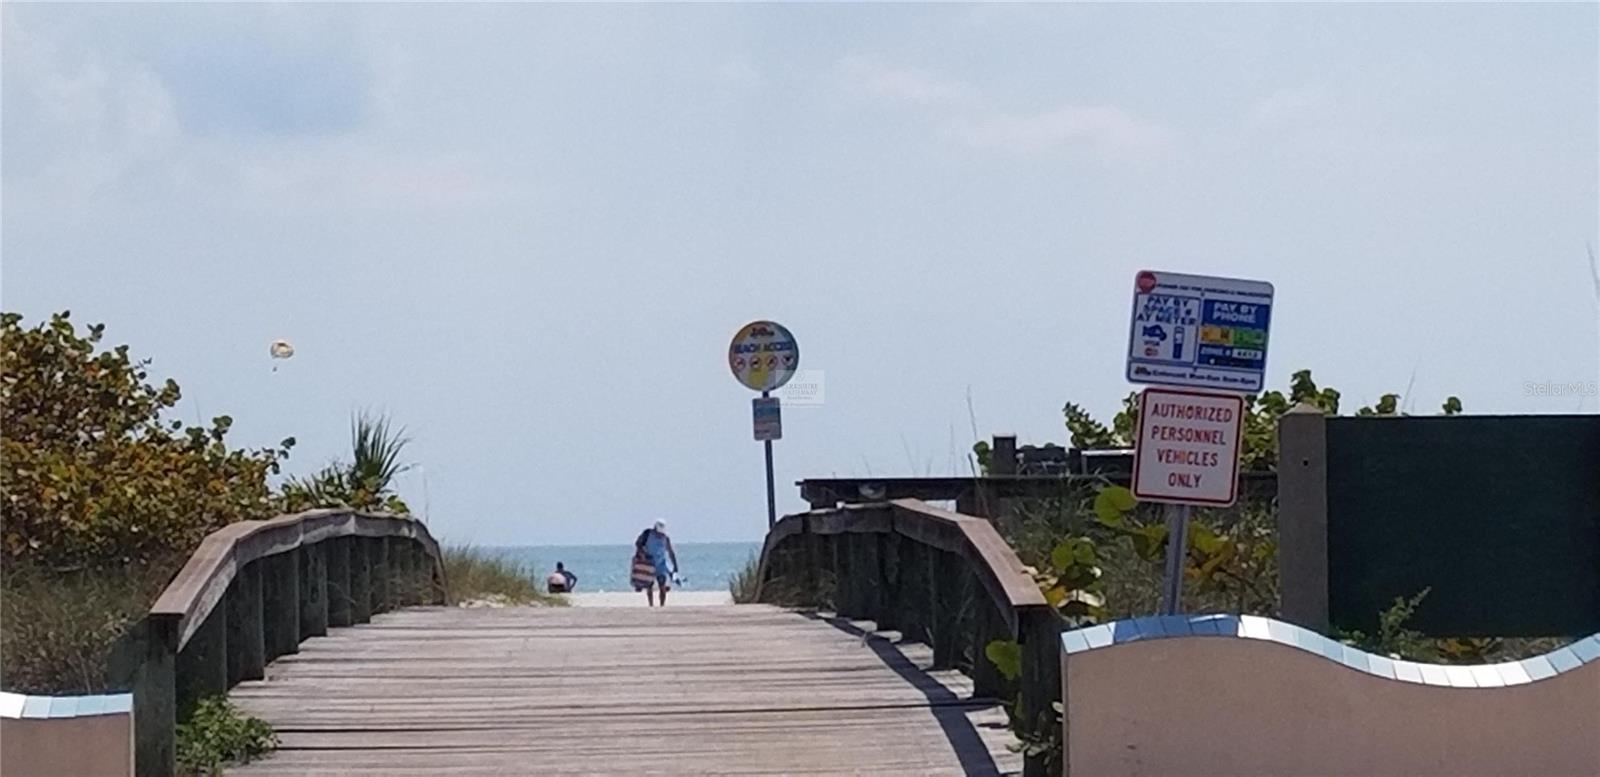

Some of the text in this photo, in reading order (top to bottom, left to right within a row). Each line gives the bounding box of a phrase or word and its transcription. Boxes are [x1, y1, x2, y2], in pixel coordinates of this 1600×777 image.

[1147, 296, 1170, 306] PAY
[1214, 303, 1258, 314] PAY BY
[1212, 311, 1256, 323] PHONE
[1151, 403, 1233, 422] AUTHORIZED
[1151, 425, 1227, 445] PERSONNEL
[1157, 448, 1219, 467] VEHICLES
[1168, 472, 1202, 488] ONLY
